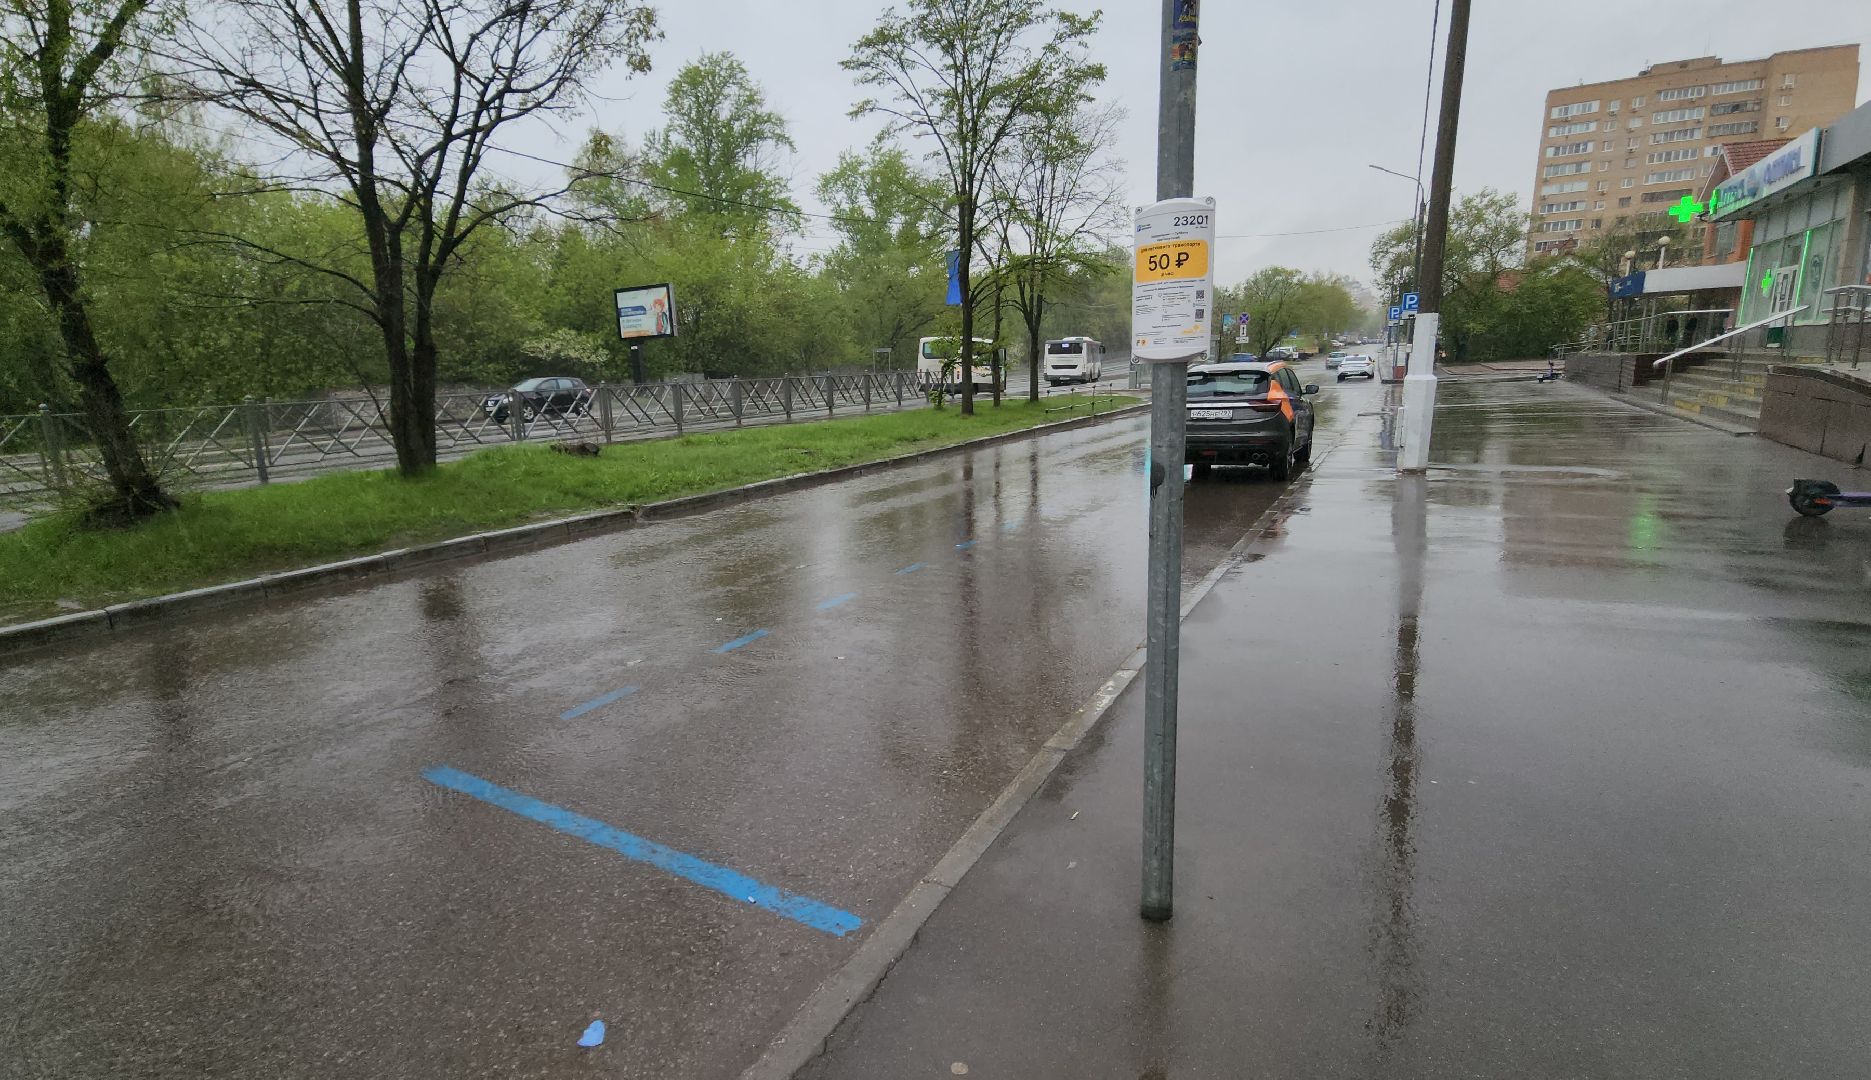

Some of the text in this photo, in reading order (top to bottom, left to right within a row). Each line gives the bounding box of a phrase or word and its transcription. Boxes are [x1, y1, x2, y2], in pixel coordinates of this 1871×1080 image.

[1174, 215, 1208, 226] 23201
[1149, 252, 1189, 272] 50 ₽
[1406, 295, 1418, 309] P
[1391, 308, 1400, 318] P
